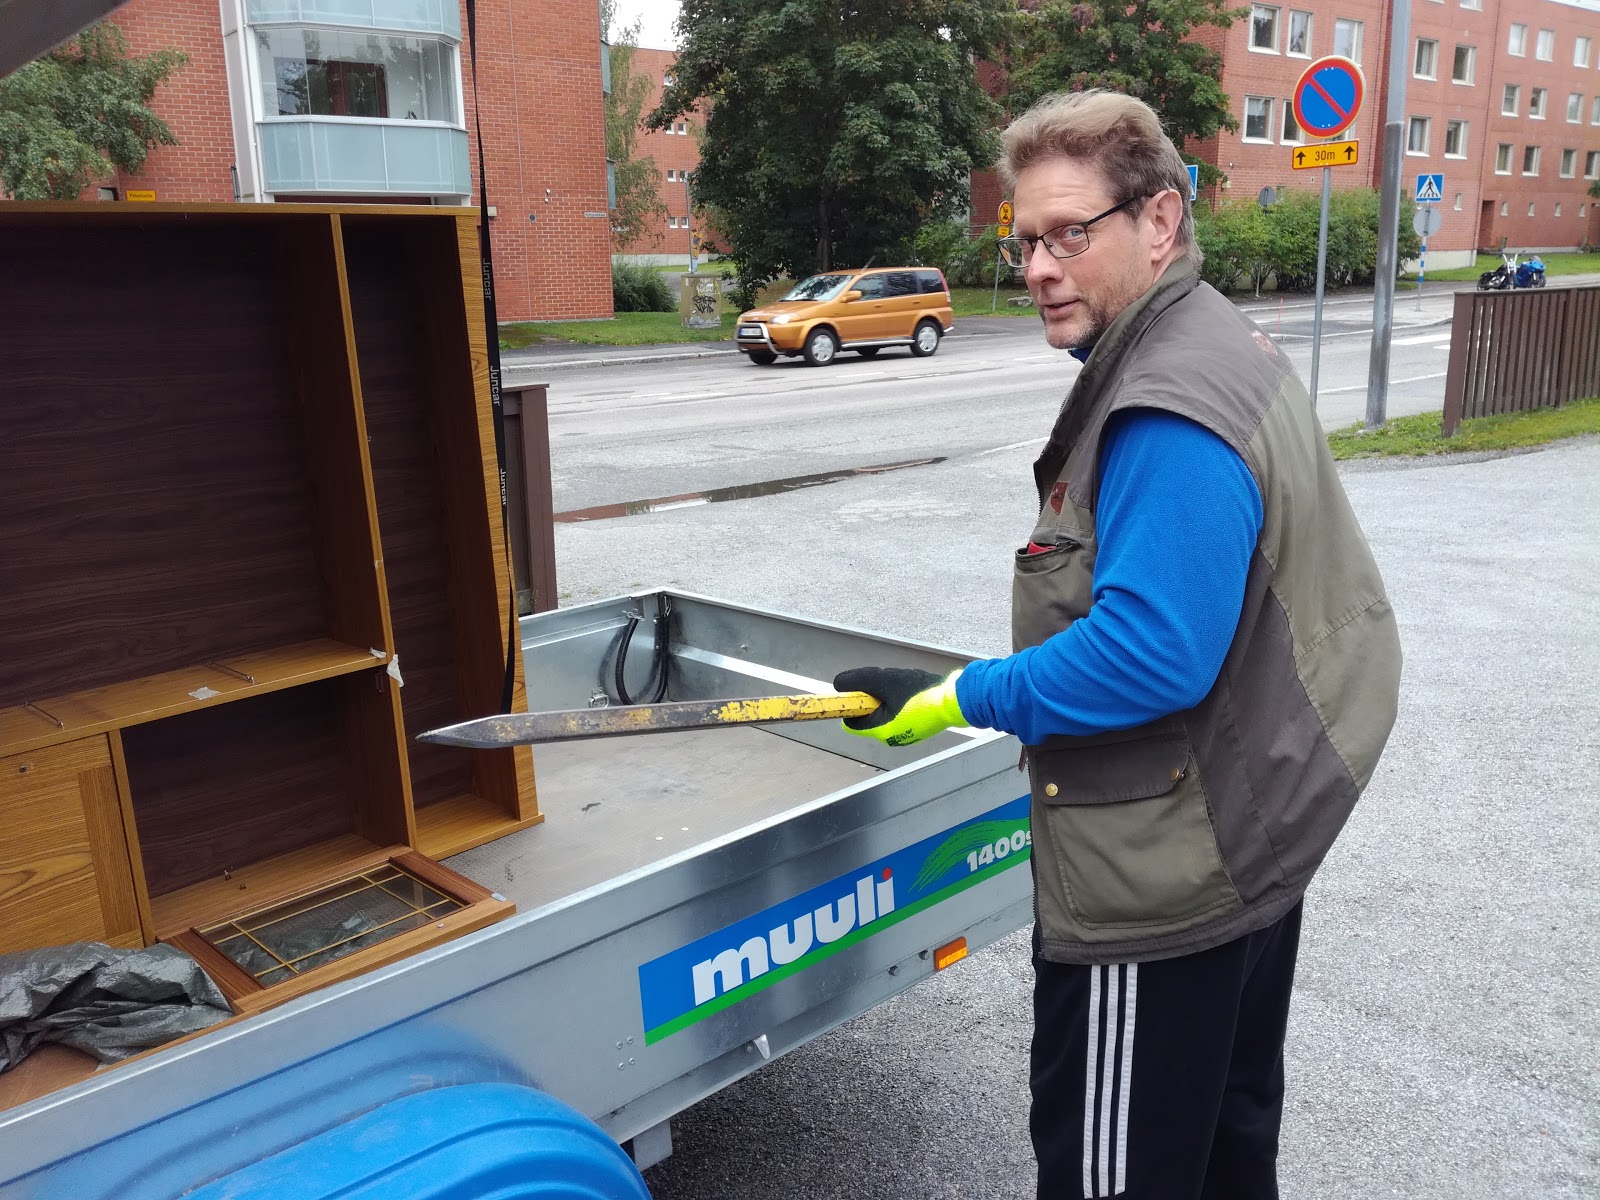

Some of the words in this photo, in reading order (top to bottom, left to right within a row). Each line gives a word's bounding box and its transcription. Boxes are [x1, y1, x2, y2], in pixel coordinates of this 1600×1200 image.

[1314, 150, 1335, 161] 30m
[482, 258, 492, 301] Juncar
[490, 366, 500, 406] Juncar
[692, 867, 895, 1006] muuli
